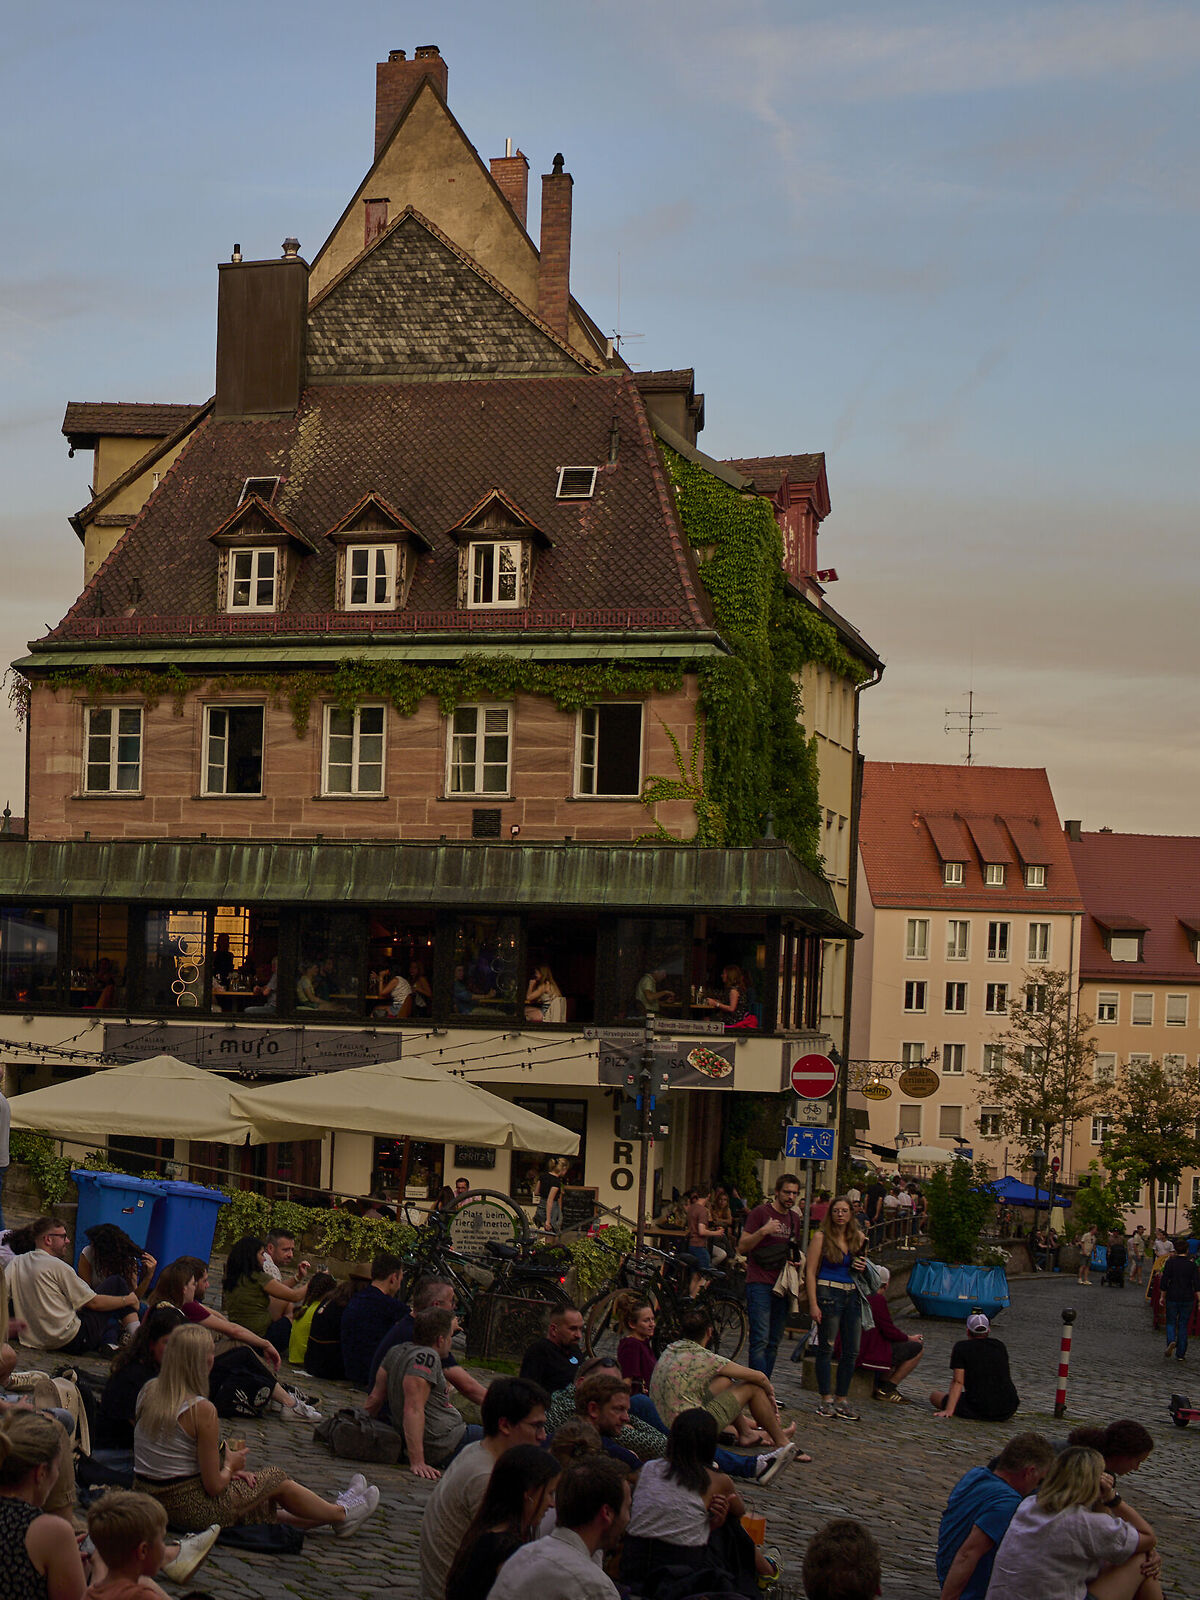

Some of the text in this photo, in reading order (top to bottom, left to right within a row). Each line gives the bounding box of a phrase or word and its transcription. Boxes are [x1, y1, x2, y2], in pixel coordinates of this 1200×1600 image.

[220, 1038, 279, 1058] muro
[604, 1056, 630, 1067] PIZZ
[485, 1210, 505, 1219] beim
[455, 1219, 511, 1228] Tiergtnertor
[415, 1352, 435, 1368] SD
